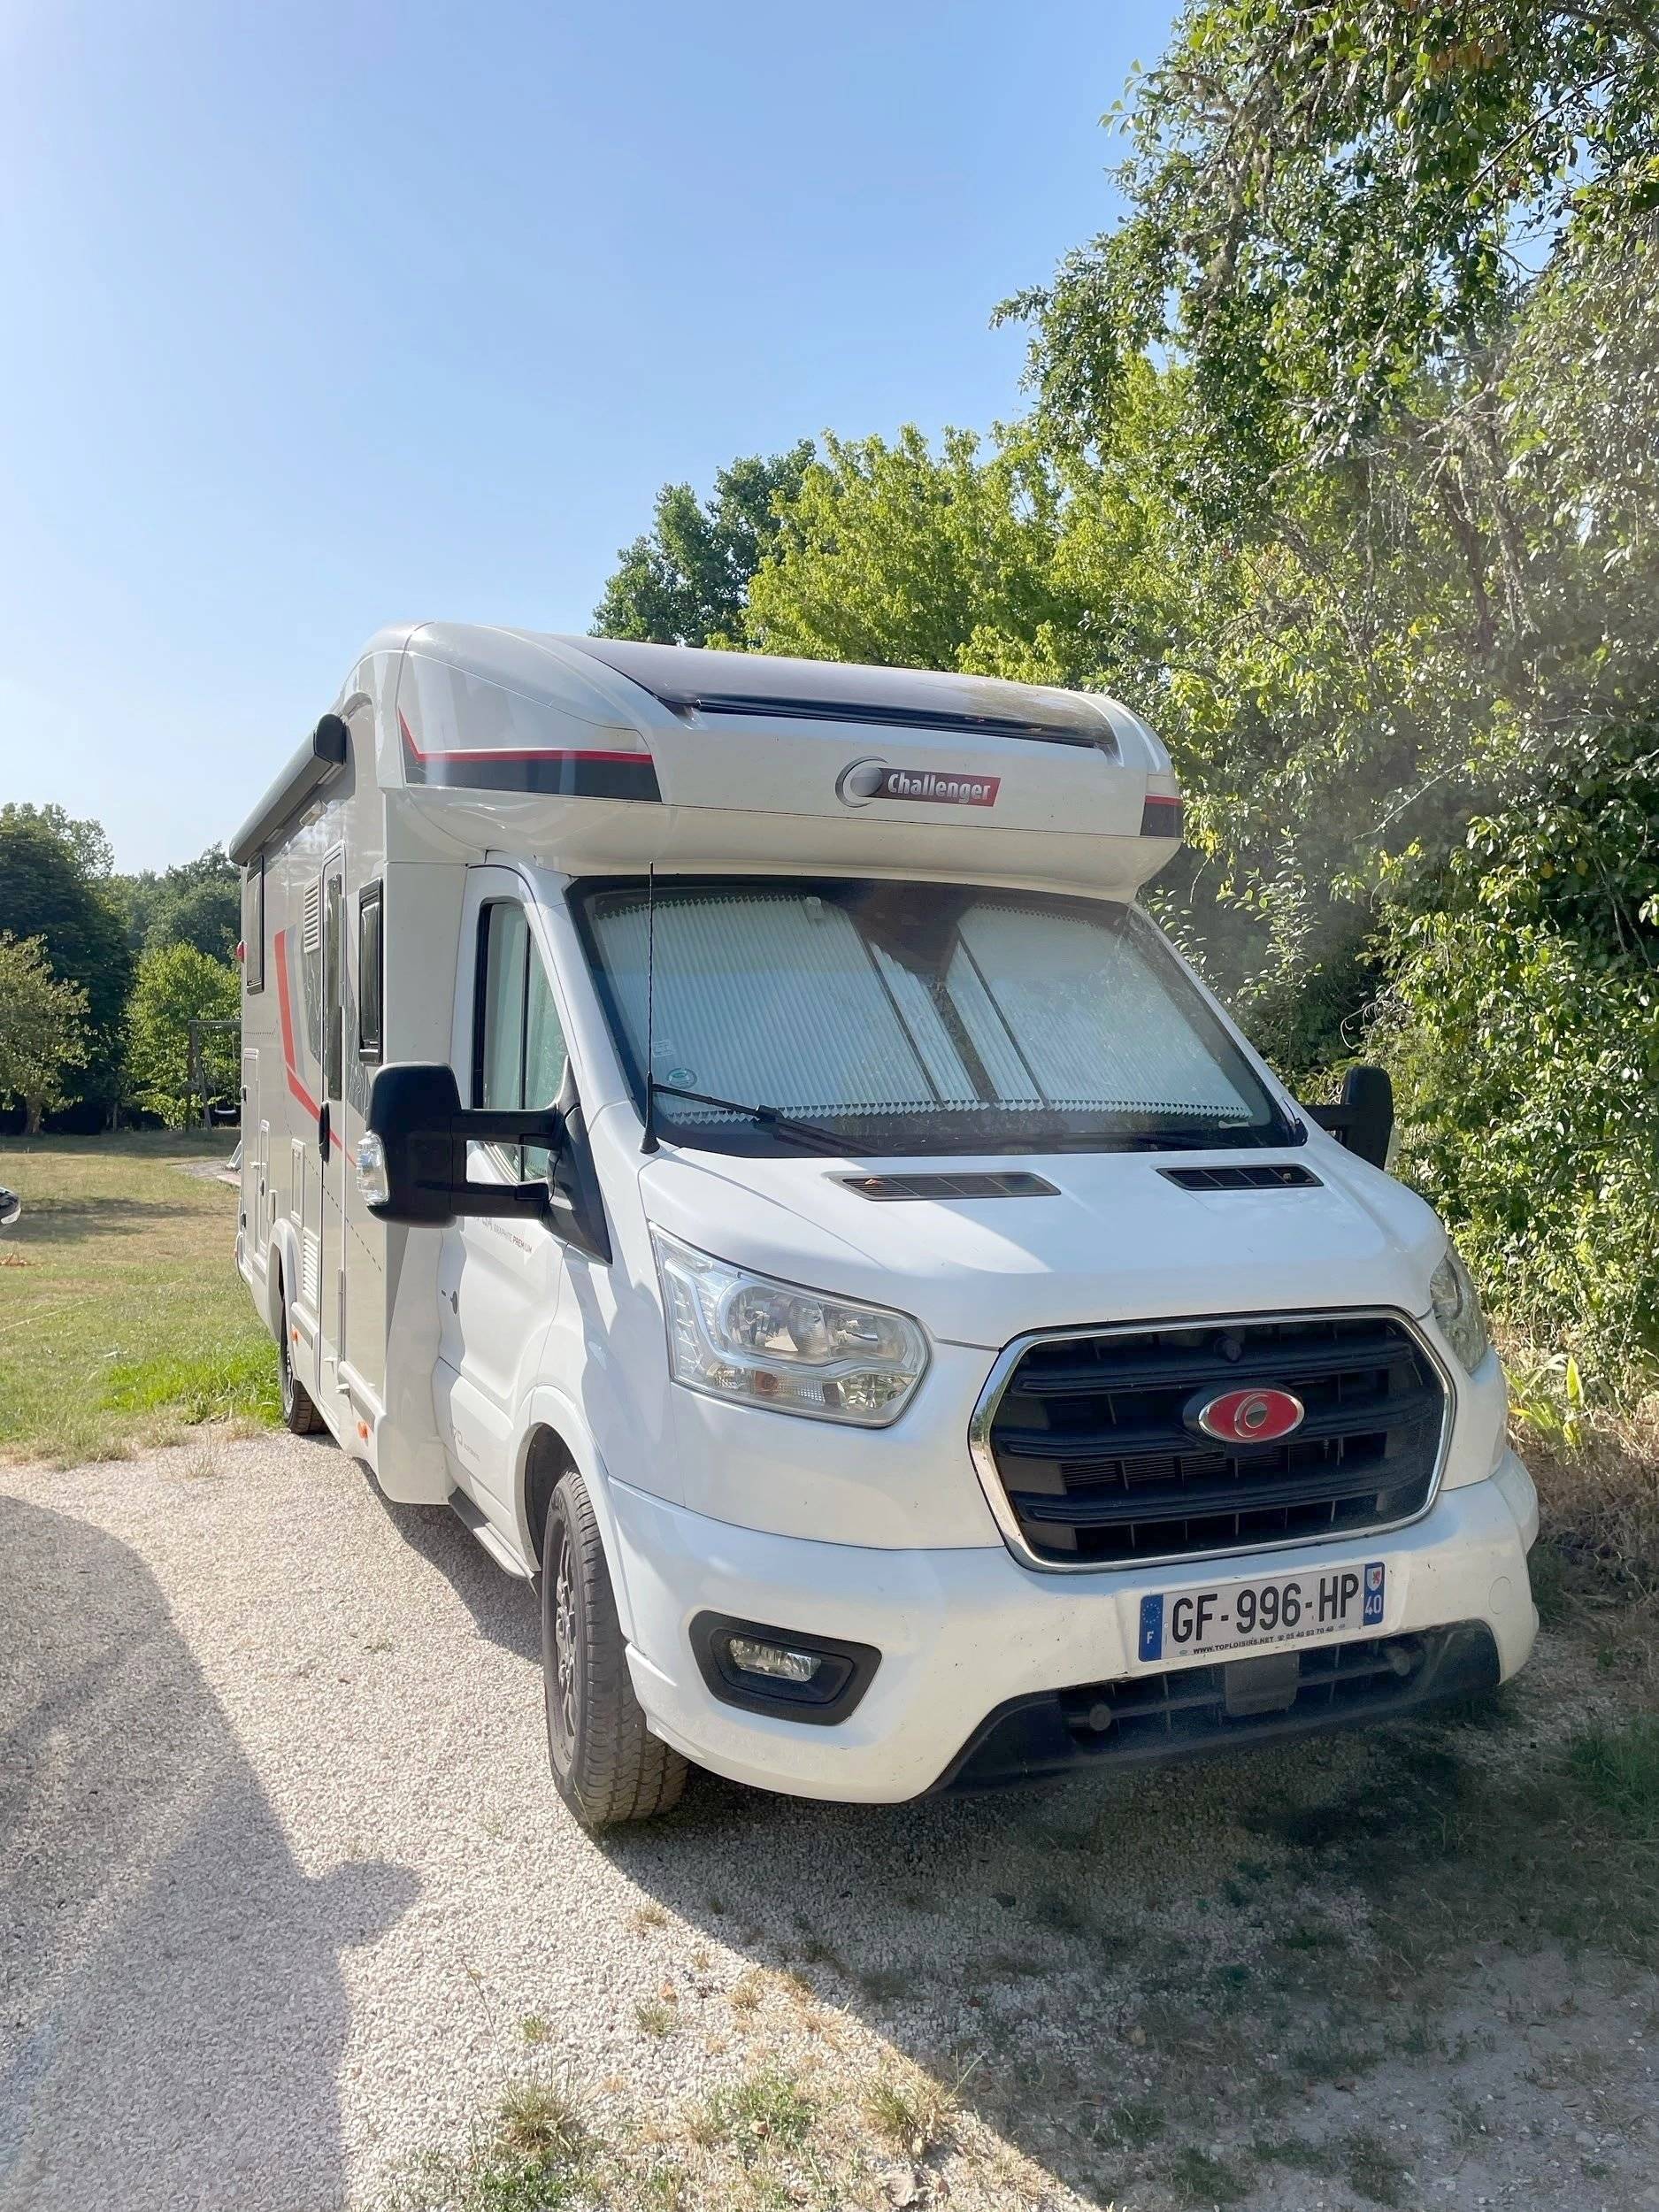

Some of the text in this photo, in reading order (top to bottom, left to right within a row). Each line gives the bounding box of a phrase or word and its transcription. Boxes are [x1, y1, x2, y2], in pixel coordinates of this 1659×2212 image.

[887, 772, 990, 804] Challenger
[1172, 1573, 1359, 1643] GF-996-HP
[1364, 1594, 1382, 1615] 40
[1146, 1631, 1154, 1645] F
[1193, 1636, 1274, 1655] WWW.TOPLOISIRS.NET
